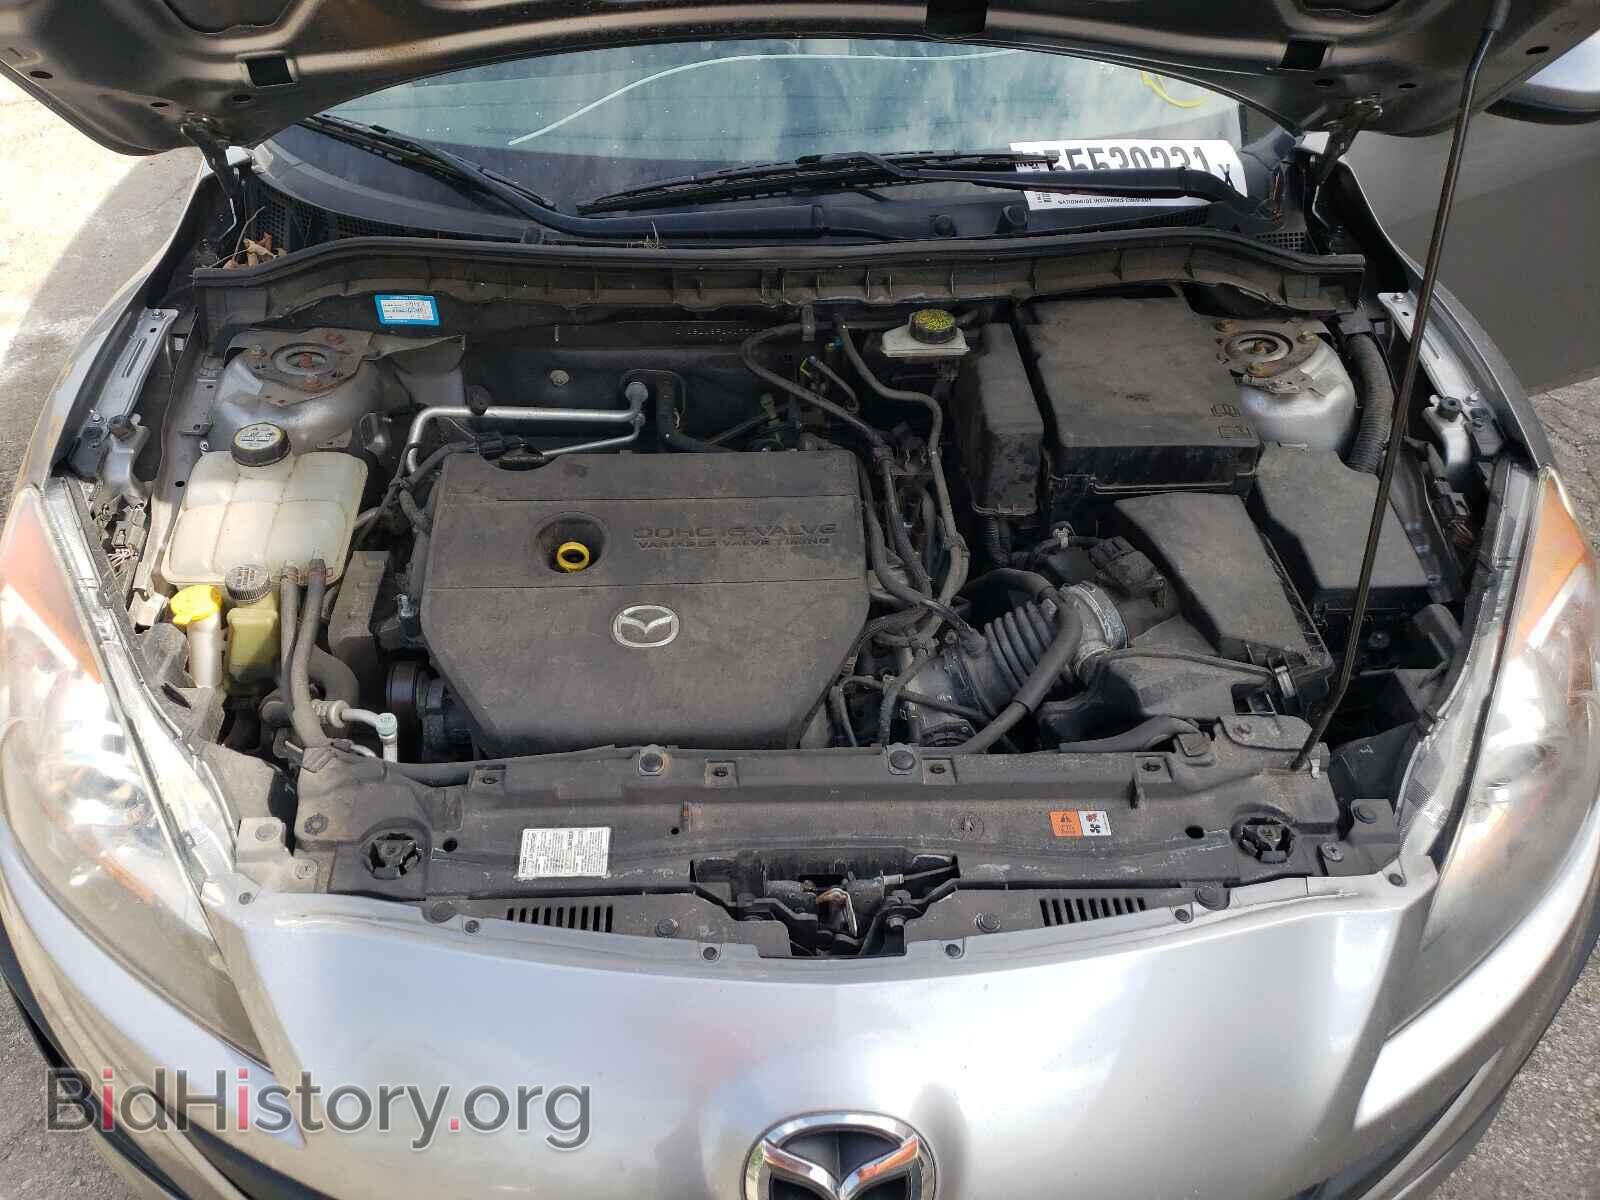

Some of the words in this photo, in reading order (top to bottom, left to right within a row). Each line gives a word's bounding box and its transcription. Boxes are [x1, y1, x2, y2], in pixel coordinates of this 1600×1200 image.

[632, 526, 713, 539] DOHC
[638, 540, 717, 549] VARIABLE
[722, 538, 770, 547] VALVE
